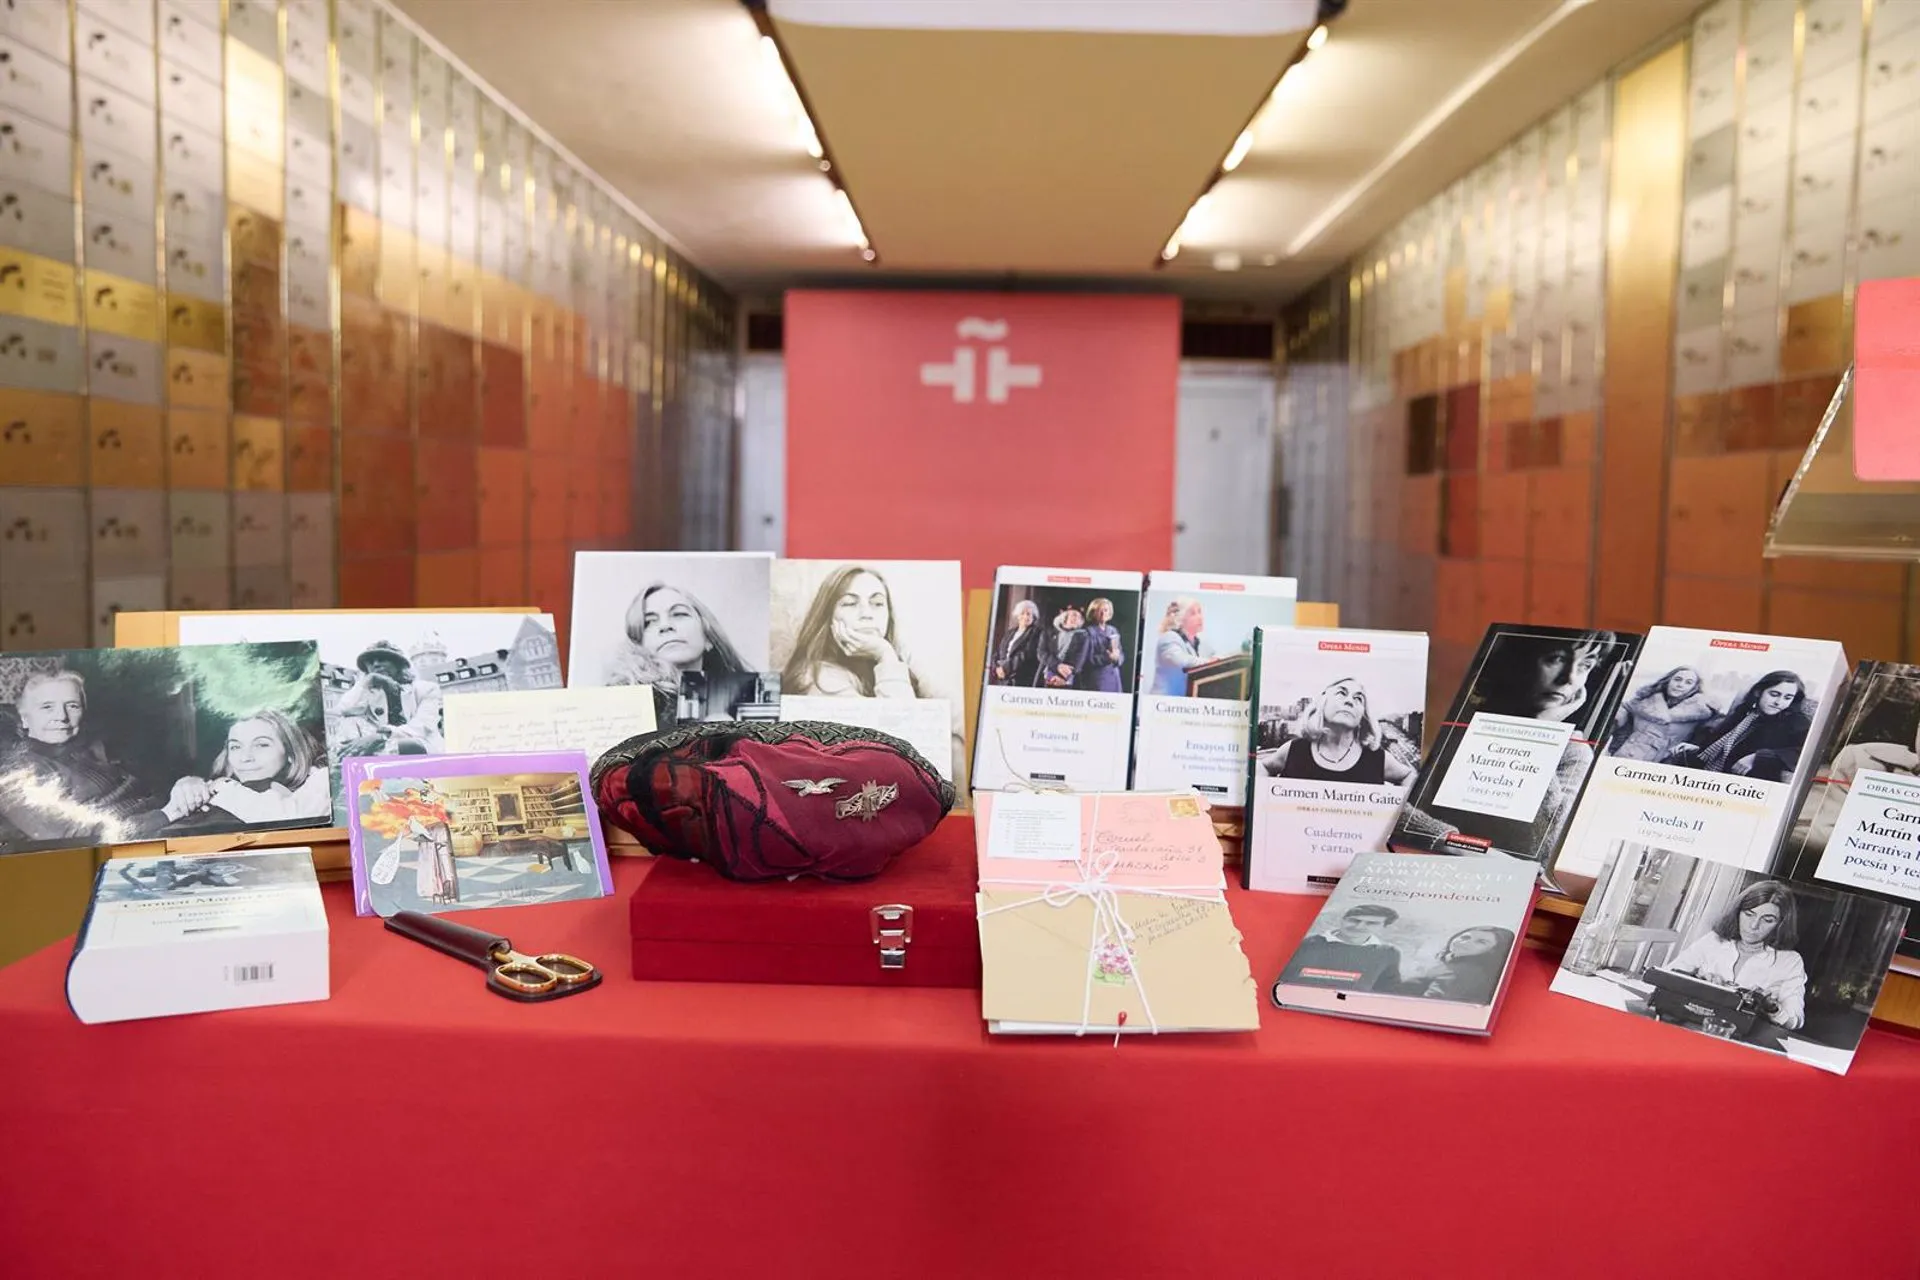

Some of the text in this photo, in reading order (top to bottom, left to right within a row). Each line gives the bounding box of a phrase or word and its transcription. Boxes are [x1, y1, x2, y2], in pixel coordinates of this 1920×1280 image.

[1001, 691, 1043, 705] Carmen
[1087, 697, 1116, 710] Gaite
[1156, 701, 1199, 714] Carmen
[1186, 739, 1240, 754] Ensayos III
[1487, 741, 1531, 758] Carmen
[1509, 759, 1541, 774] Gaite
[1469, 770, 1524, 789] Novelas I
[1614, 765, 1765, 800] Carmen Martín Gaite
[1271, 784, 1319, 800] Carmen
[1368, 792, 1402, 806] Gaite
[1866, 783, 1901, 795] OBRAS
[1640, 811, 1705, 832] Novelas II
[1857, 820, 1912, 841] Martín
[1304, 826, 1363, 840] Cuadernos
[1311, 844, 1354, 854] y cartas
[1845, 836, 1911, 860] Narrativa
[1844, 855, 1887, 871] poesía
[1890, 864, 1901, 875] y
[1358, 876, 1408, 886] JUAN
[1353, 885, 1501, 903] Correspondencia
